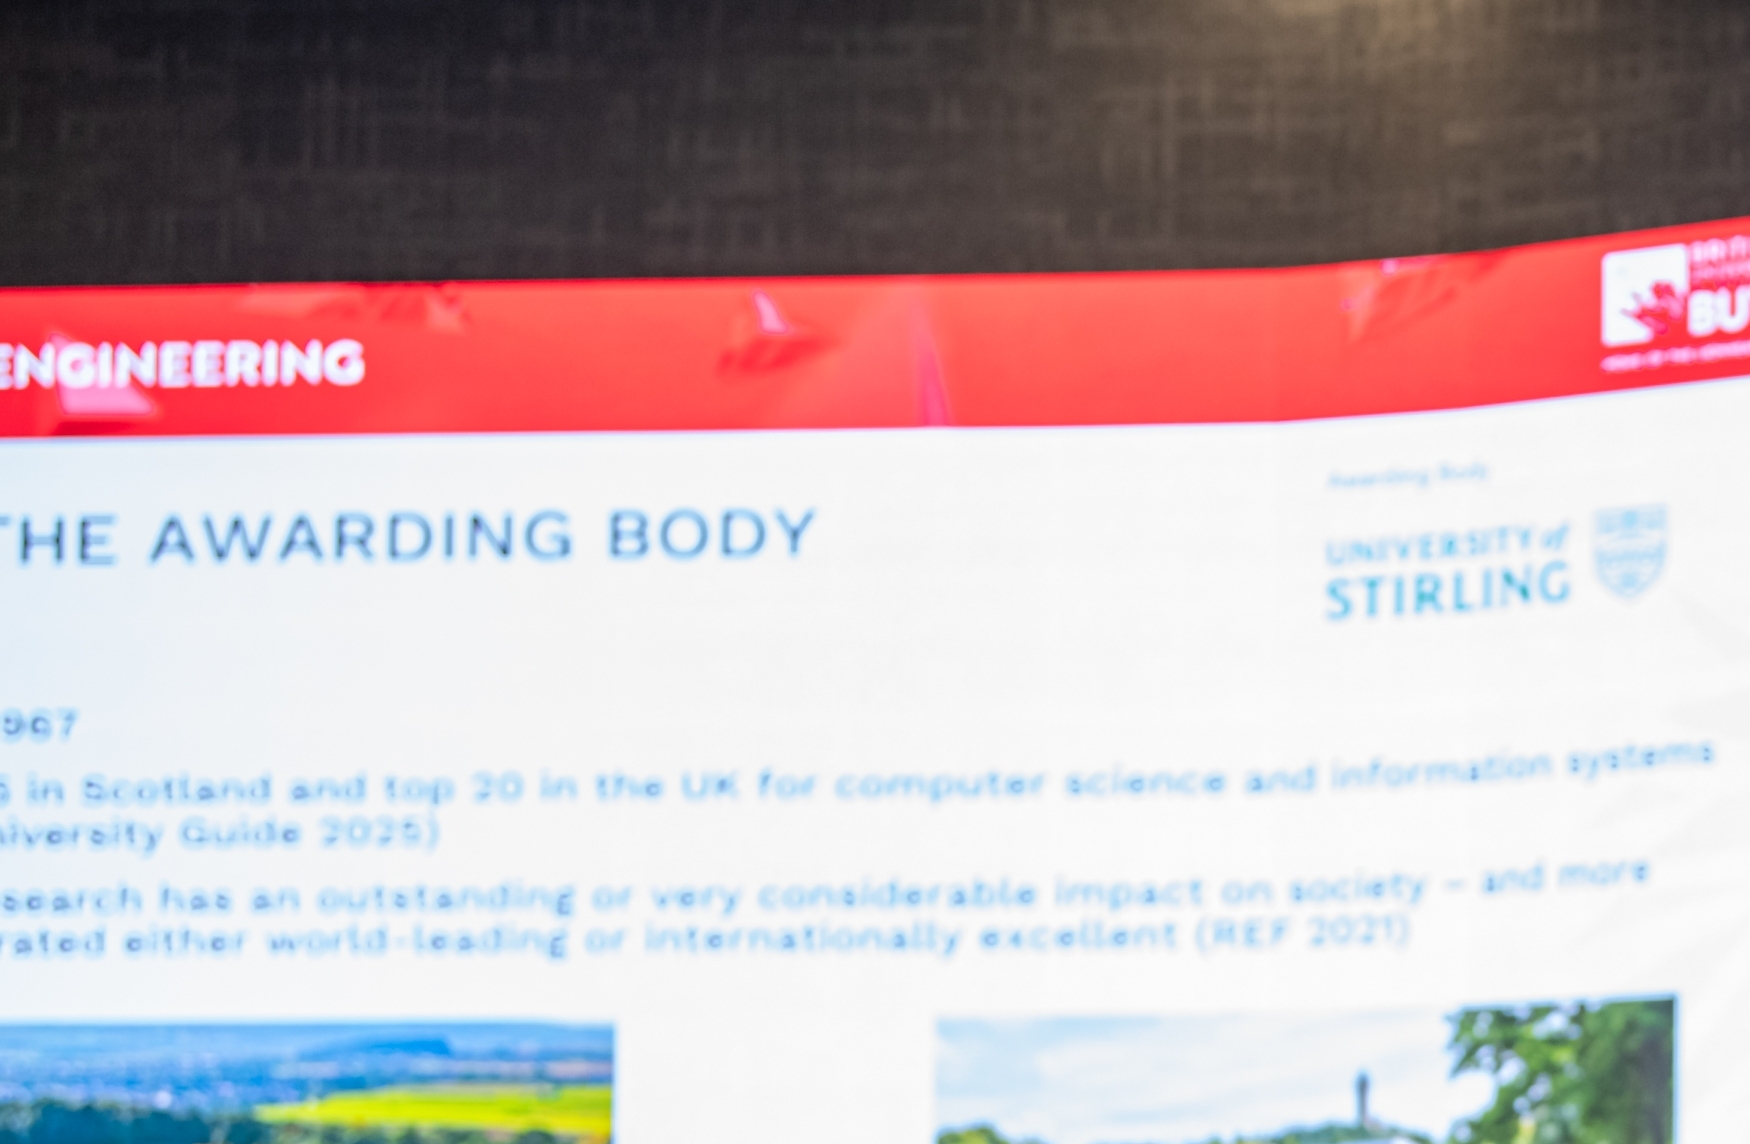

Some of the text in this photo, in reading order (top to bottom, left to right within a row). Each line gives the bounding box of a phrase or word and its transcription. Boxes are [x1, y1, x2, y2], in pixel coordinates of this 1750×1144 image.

[0, 508, 815, 566] HE AWARDING BODY
[1326, 523, 1570, 566] UNIVERSITY of
[1326, 560, 1570, 621] STIRLING
[0, 821, 163, 857] iversity
